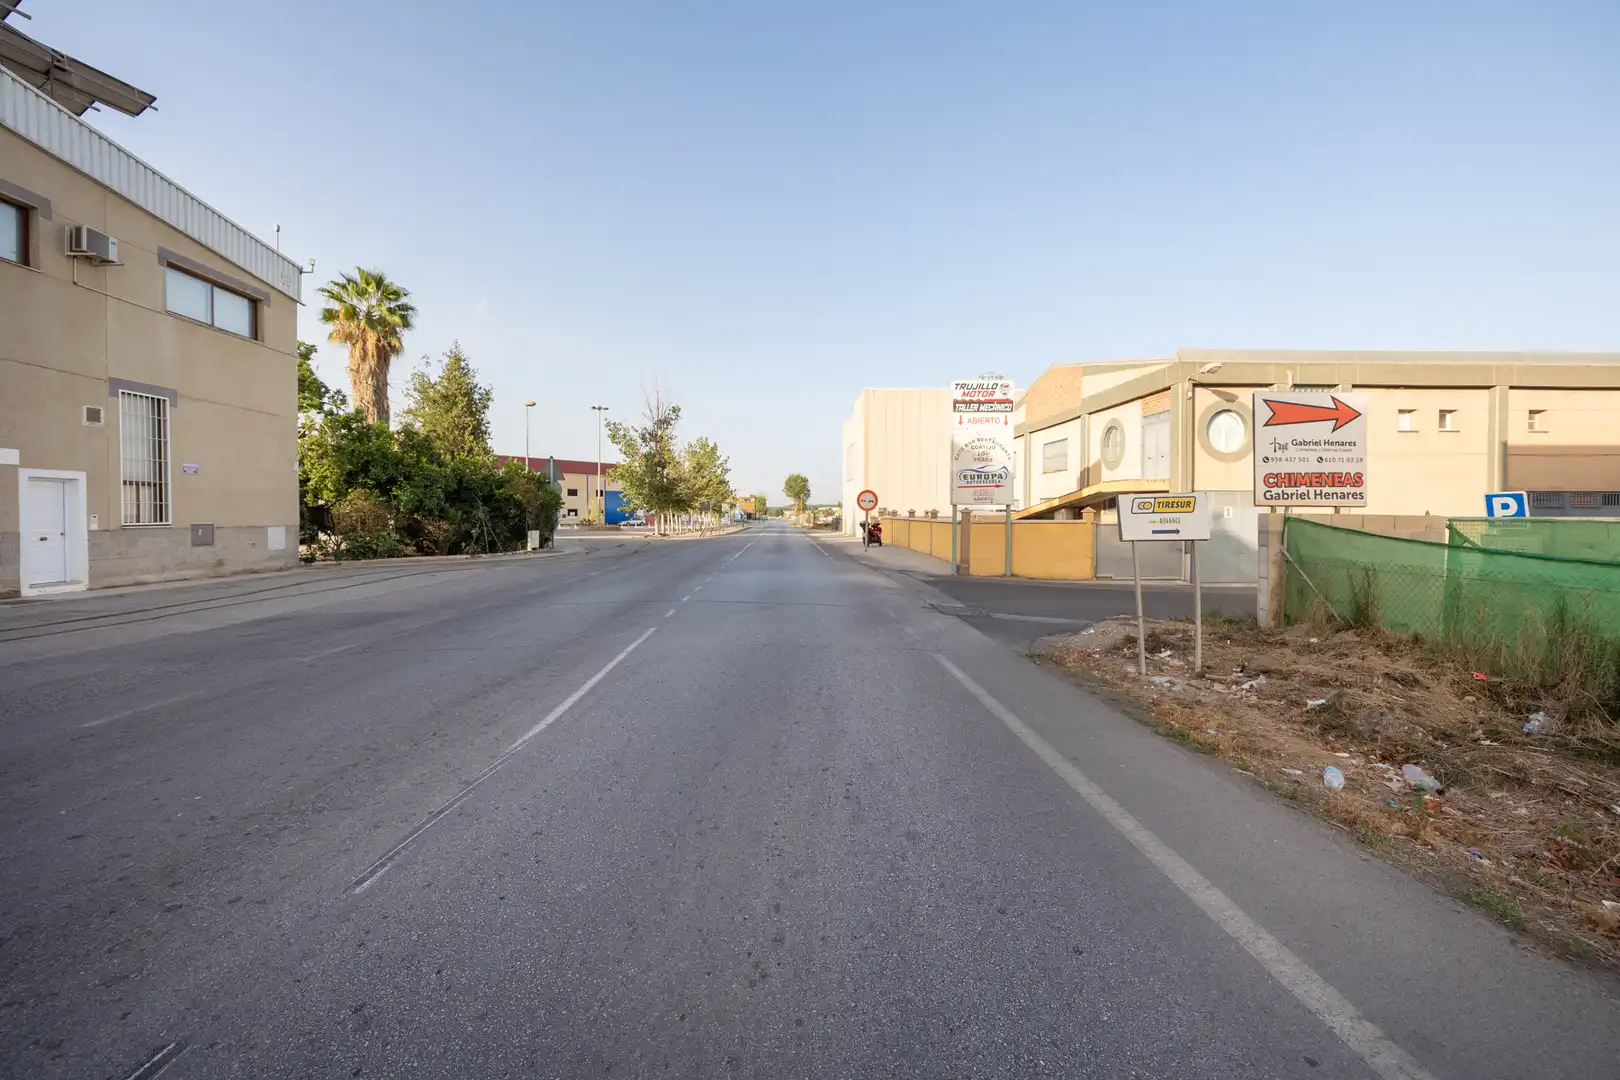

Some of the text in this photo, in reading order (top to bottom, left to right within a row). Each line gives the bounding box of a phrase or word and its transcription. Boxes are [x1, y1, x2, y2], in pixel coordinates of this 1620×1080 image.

[955, 401, 1012, 411] TALLER MECÁNICO
[1291, 438, 1357, 447] Gabriel Henares
[962, 473, 1004, 481] EUROPA
[1263, 472, 1364, 488] CHIMENEAS
[1263, 489, 1365, 501] Gabriel Henares
[1492, 497, 1518, 518] P
